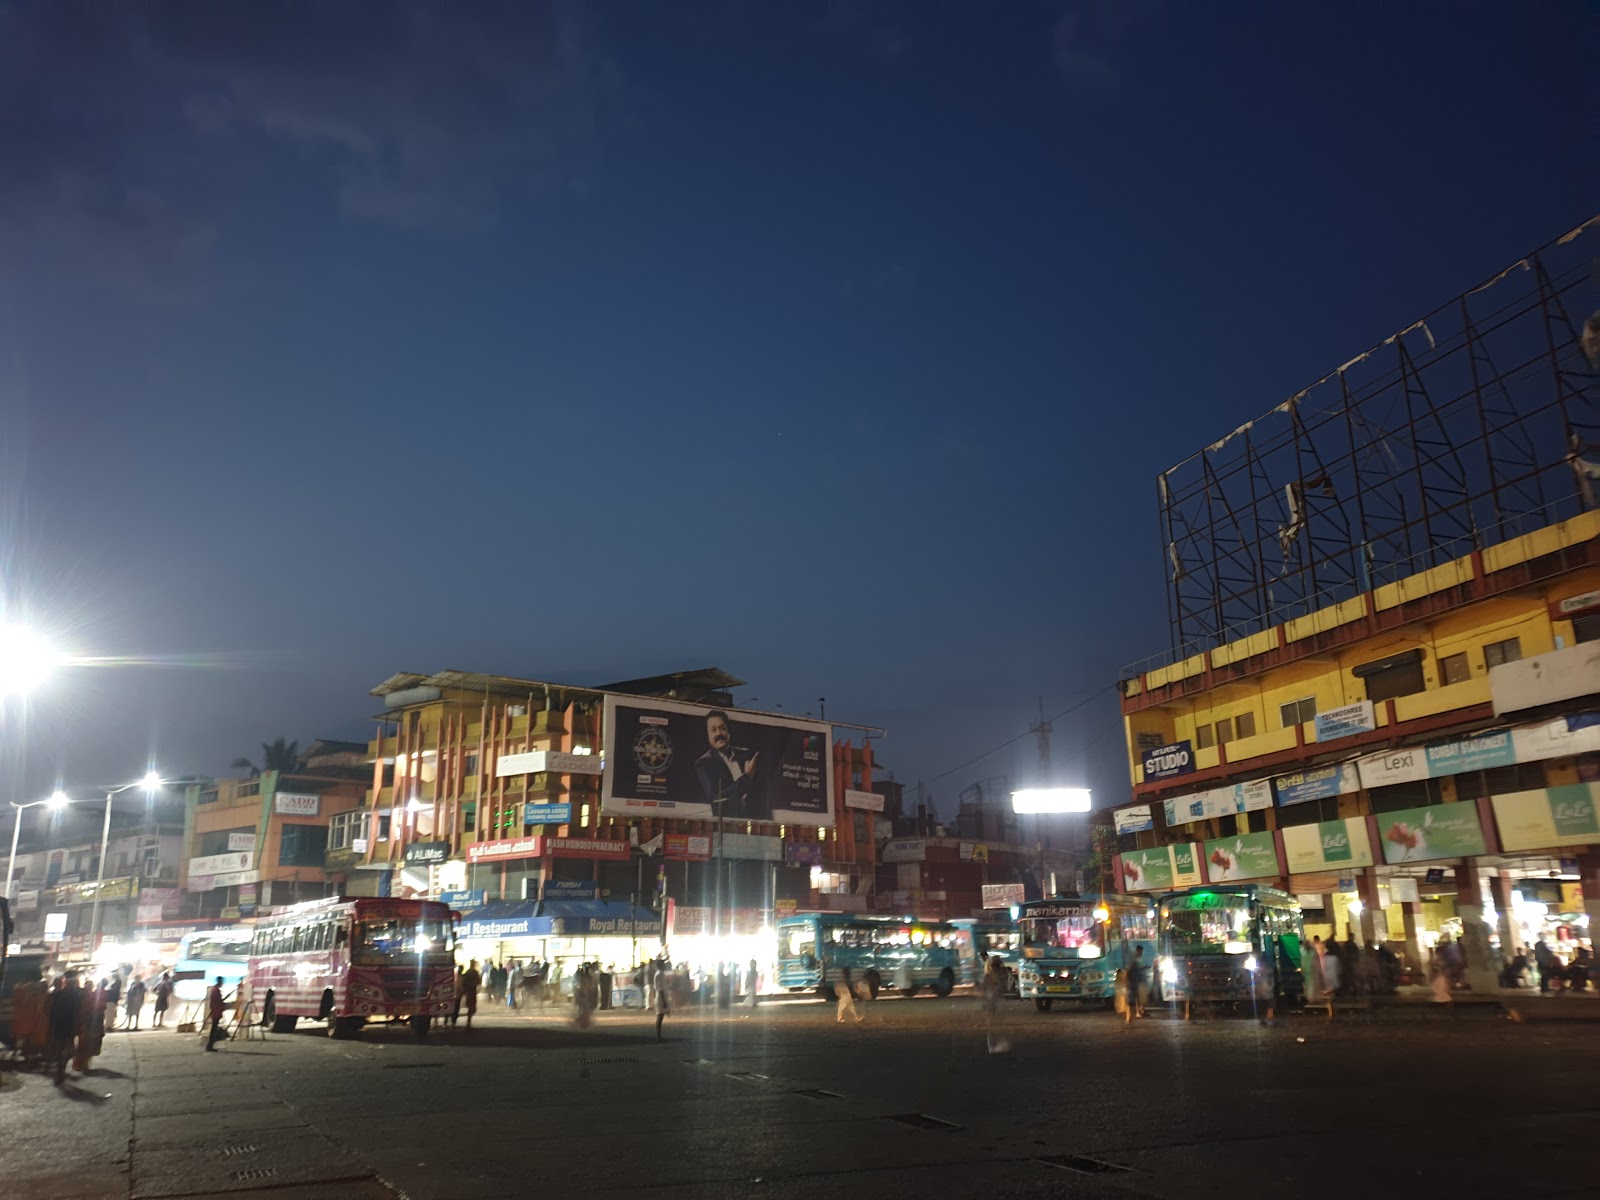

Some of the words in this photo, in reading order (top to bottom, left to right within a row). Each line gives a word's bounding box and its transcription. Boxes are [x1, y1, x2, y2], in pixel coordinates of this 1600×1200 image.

[1321, 705, 1364, 721] TECHNOSHREE
[1429, 742, 1460, 760] BOMBAY
[1460, 733, 1509, 755] STATIONERY
[549, 761, 600, 771] LODGE
[1145, 751, 1189, 774] STUDIO
[1383, 751, 1415, 771] Lexi
[279, 795, 316, 805] CADD
[1249, 791, 1263, 800] STORE
[551, 807, 569, 815] LODGE
[678, 908, 709, 918] HOTEL
[472, 920, 529, 935] Restaurant
[589, 918, 616, 933] Royal
[618, 918, 661, 932] Restaura
[678, 917, 709, 926] SELECT
